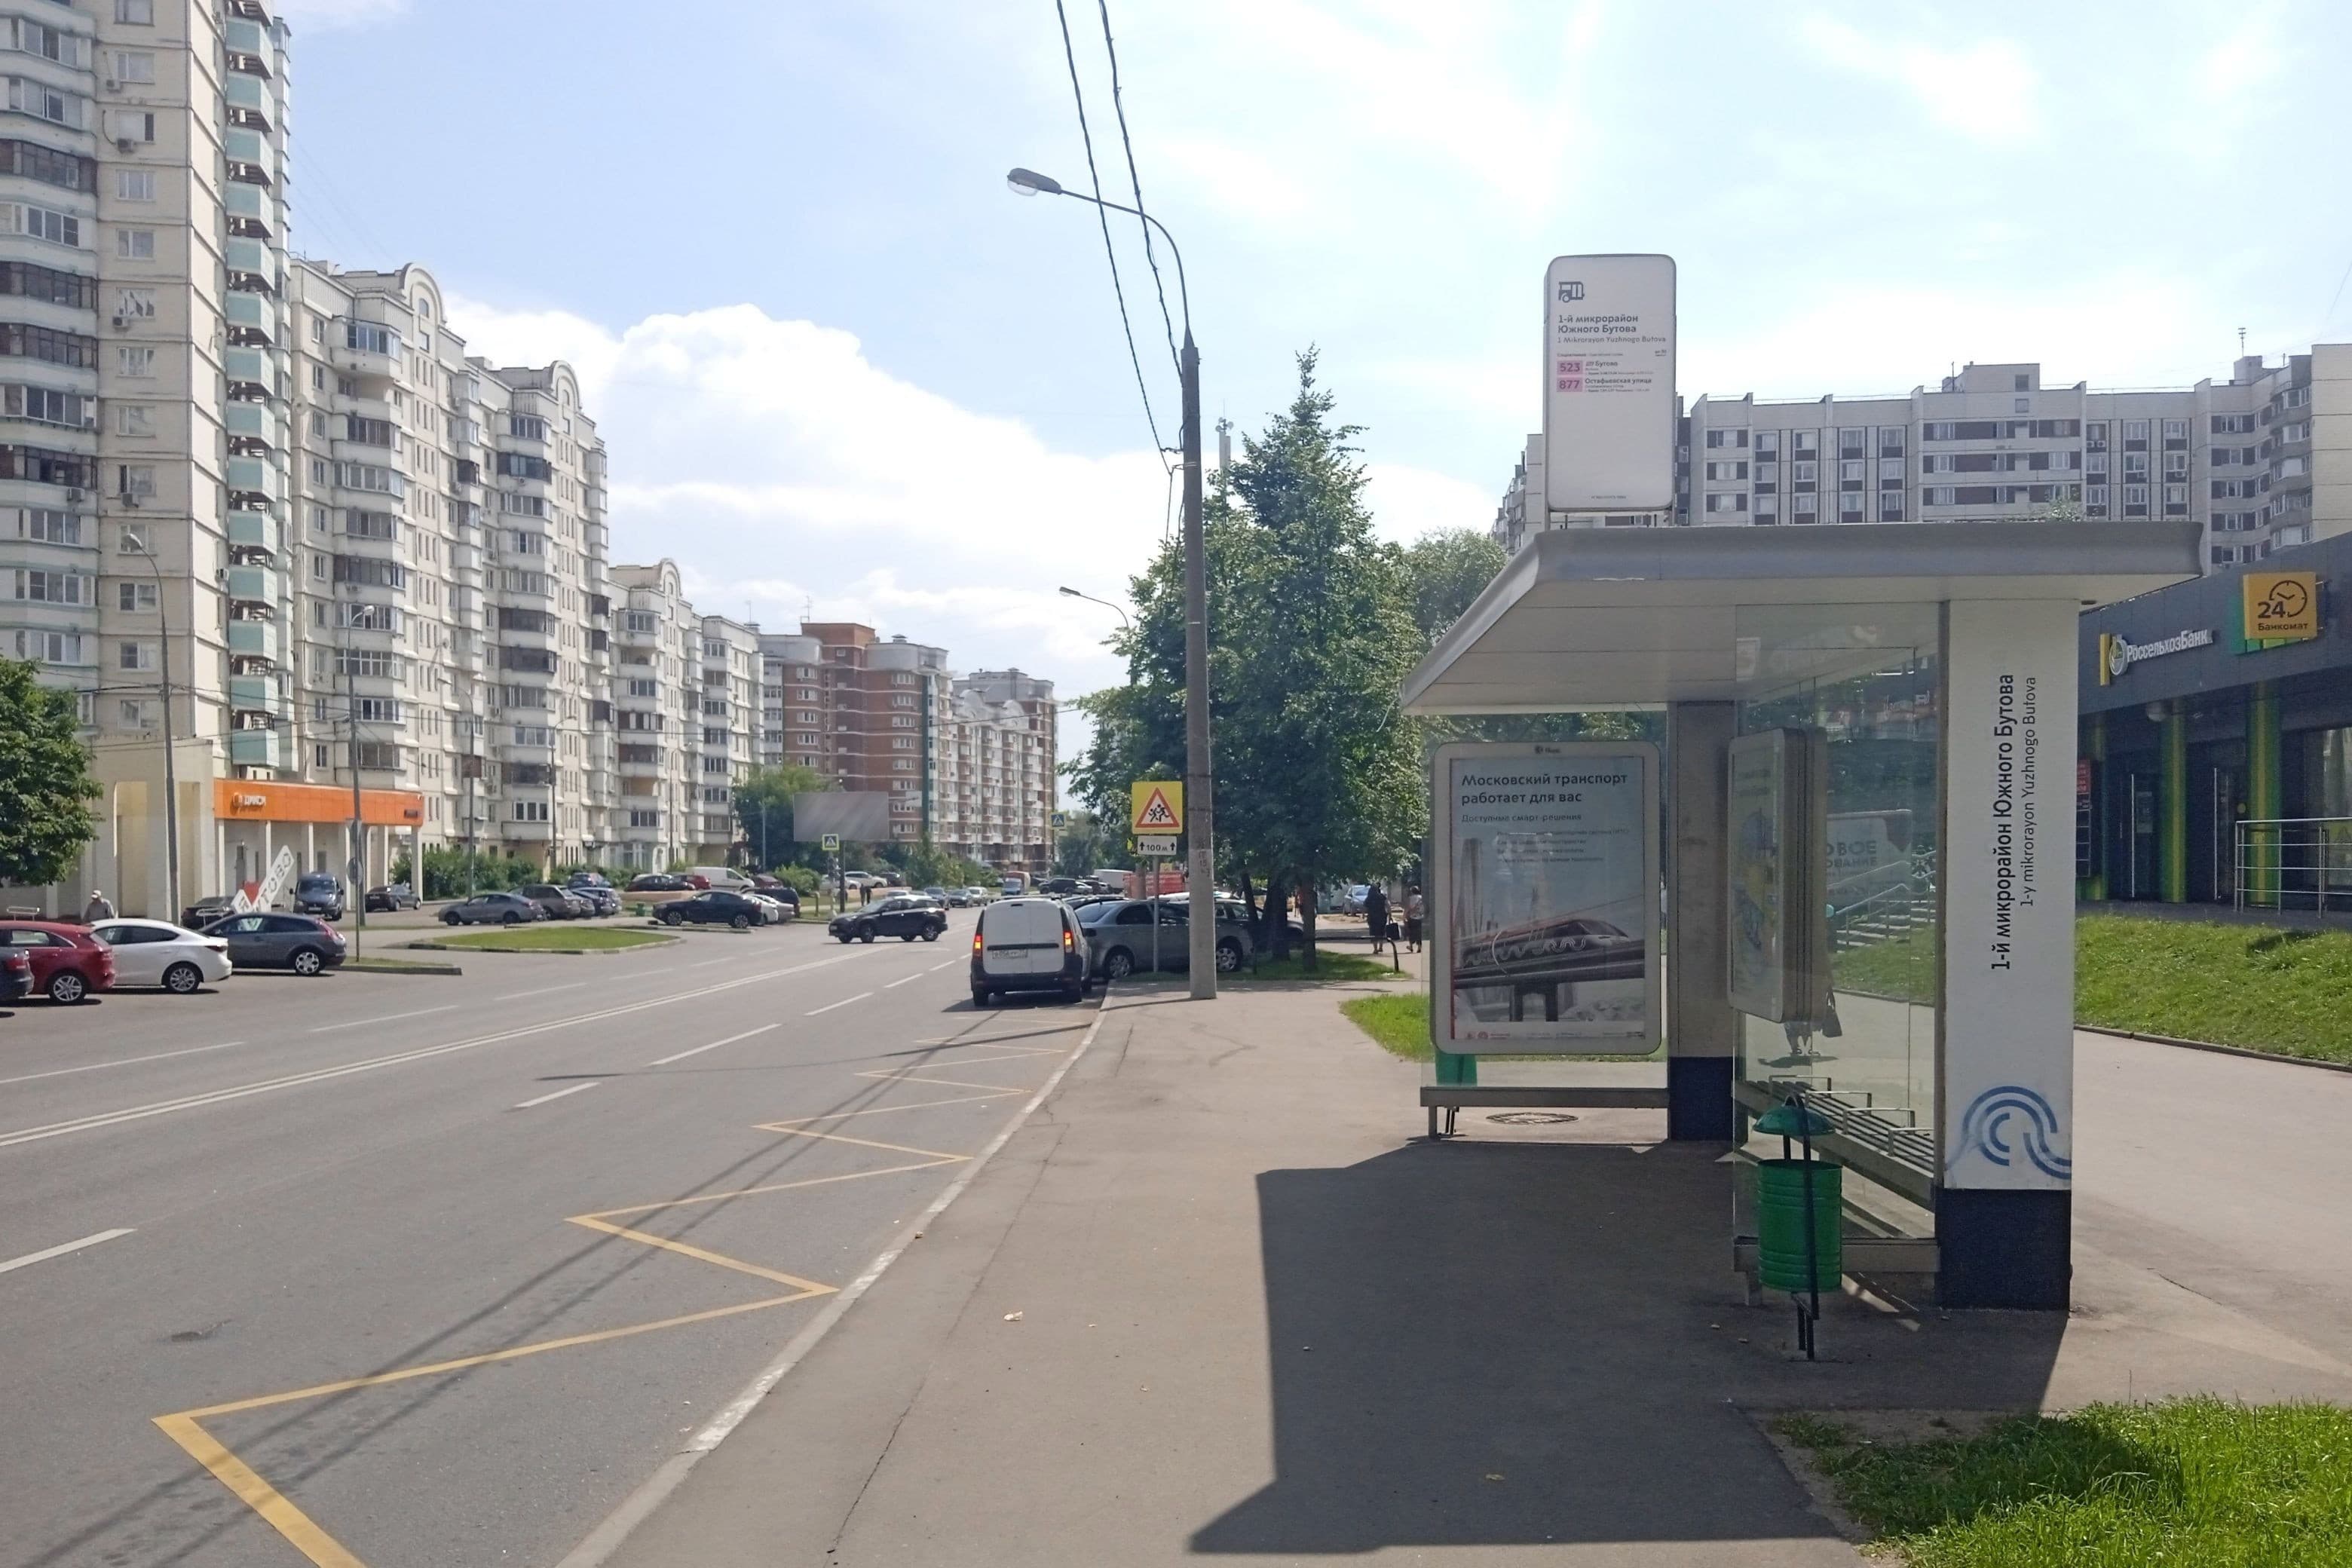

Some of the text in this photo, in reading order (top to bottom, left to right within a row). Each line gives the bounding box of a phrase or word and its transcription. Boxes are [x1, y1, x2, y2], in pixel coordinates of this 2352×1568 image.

[1576, 314, 1639, 324] микрорайон
[1557, 324, 1637, 334] Южного Бутова
[1560, 363, 1581, 372] 523
[1559, 379, 1581, 390] 877
[2257, 601, 2286, 619] 24
[2257, 620, 2309, 632] Банкомат
[2126, 628, 2209, 663] РоссельхозБанк
[1461, 773, 1628, 786] Московский транспорт
[2020, 677, 2039, 907] 1-y mikrorayon Yuzhnogo Butova
[1461, 792, 1582, 806] работает для вас
[1991, 674, 2018, 970] 1-й микрорайон Южного Бутова
